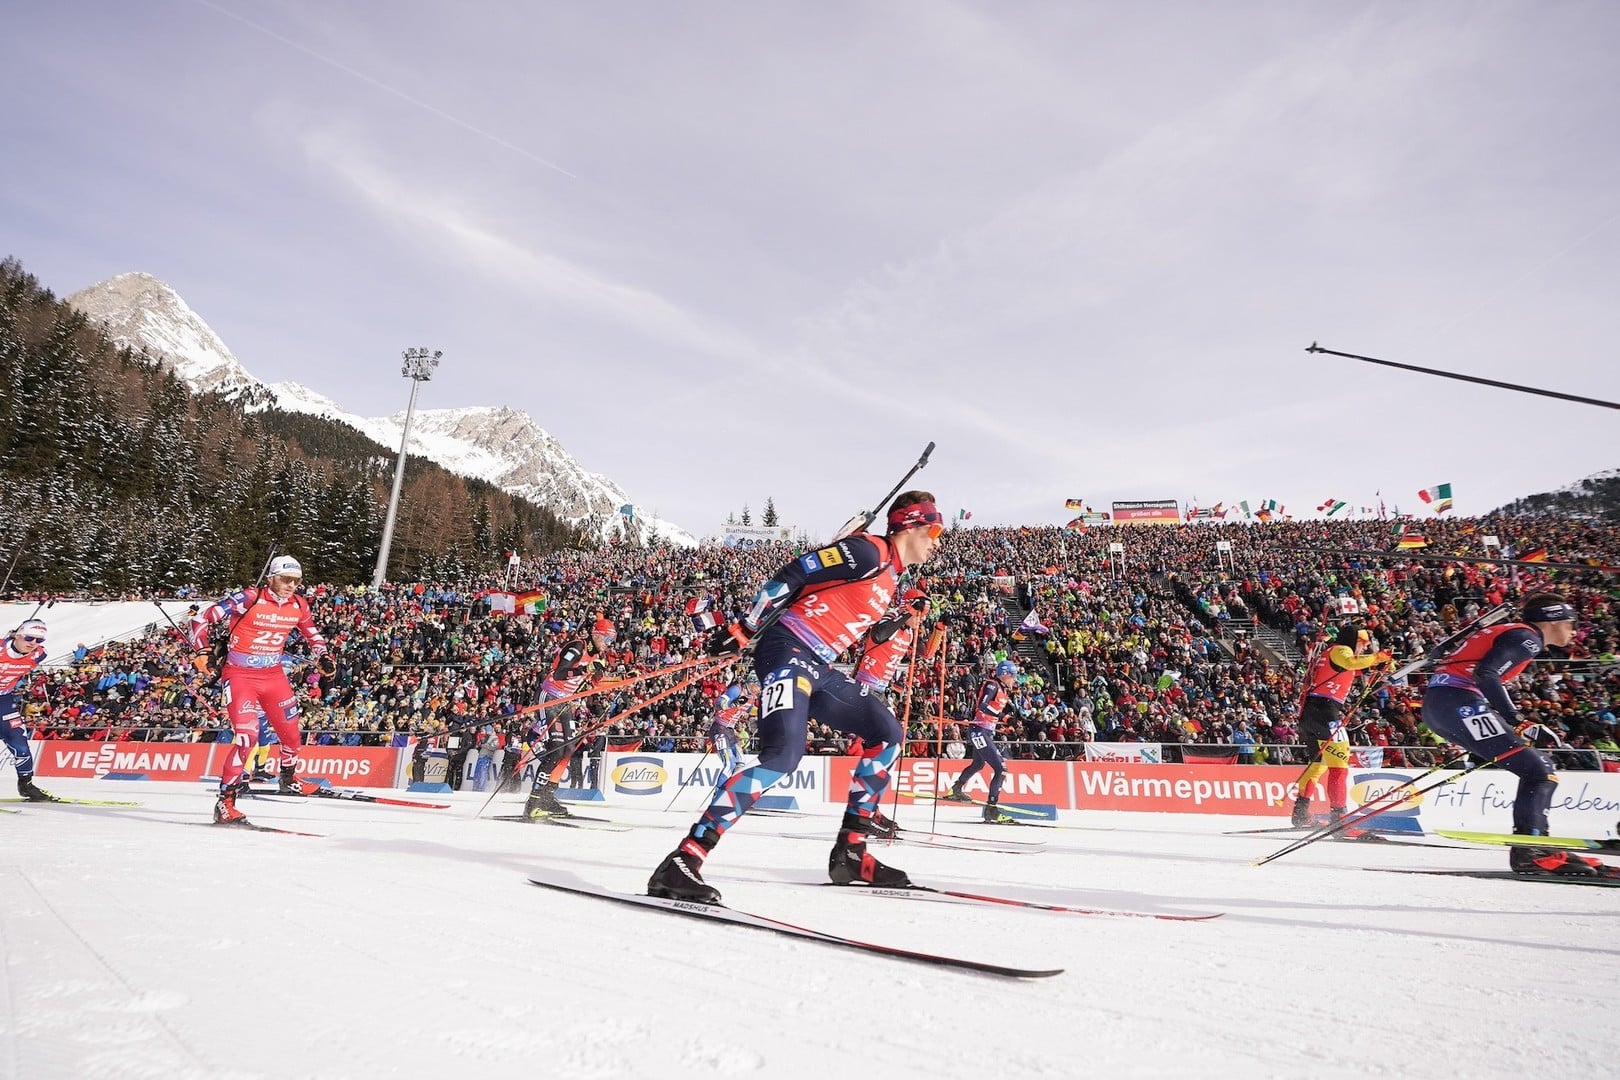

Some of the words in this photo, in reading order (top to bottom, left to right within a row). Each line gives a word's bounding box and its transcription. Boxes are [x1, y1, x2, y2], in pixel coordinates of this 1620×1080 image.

[804, 594, 829, 616] 22
[252, 630, 287, 645] 25
[864, 655, 877, 666] 23
[1327, 681, 1342, 690] 21
[766, 683, 784, 713] 22
[1472, 716, 1498, 738] 20
[1434, 781, 1471, 807] Fit
[871, 889, 911, 897] MADSHUS
[672, 902, 710, 913] MADSHUS
